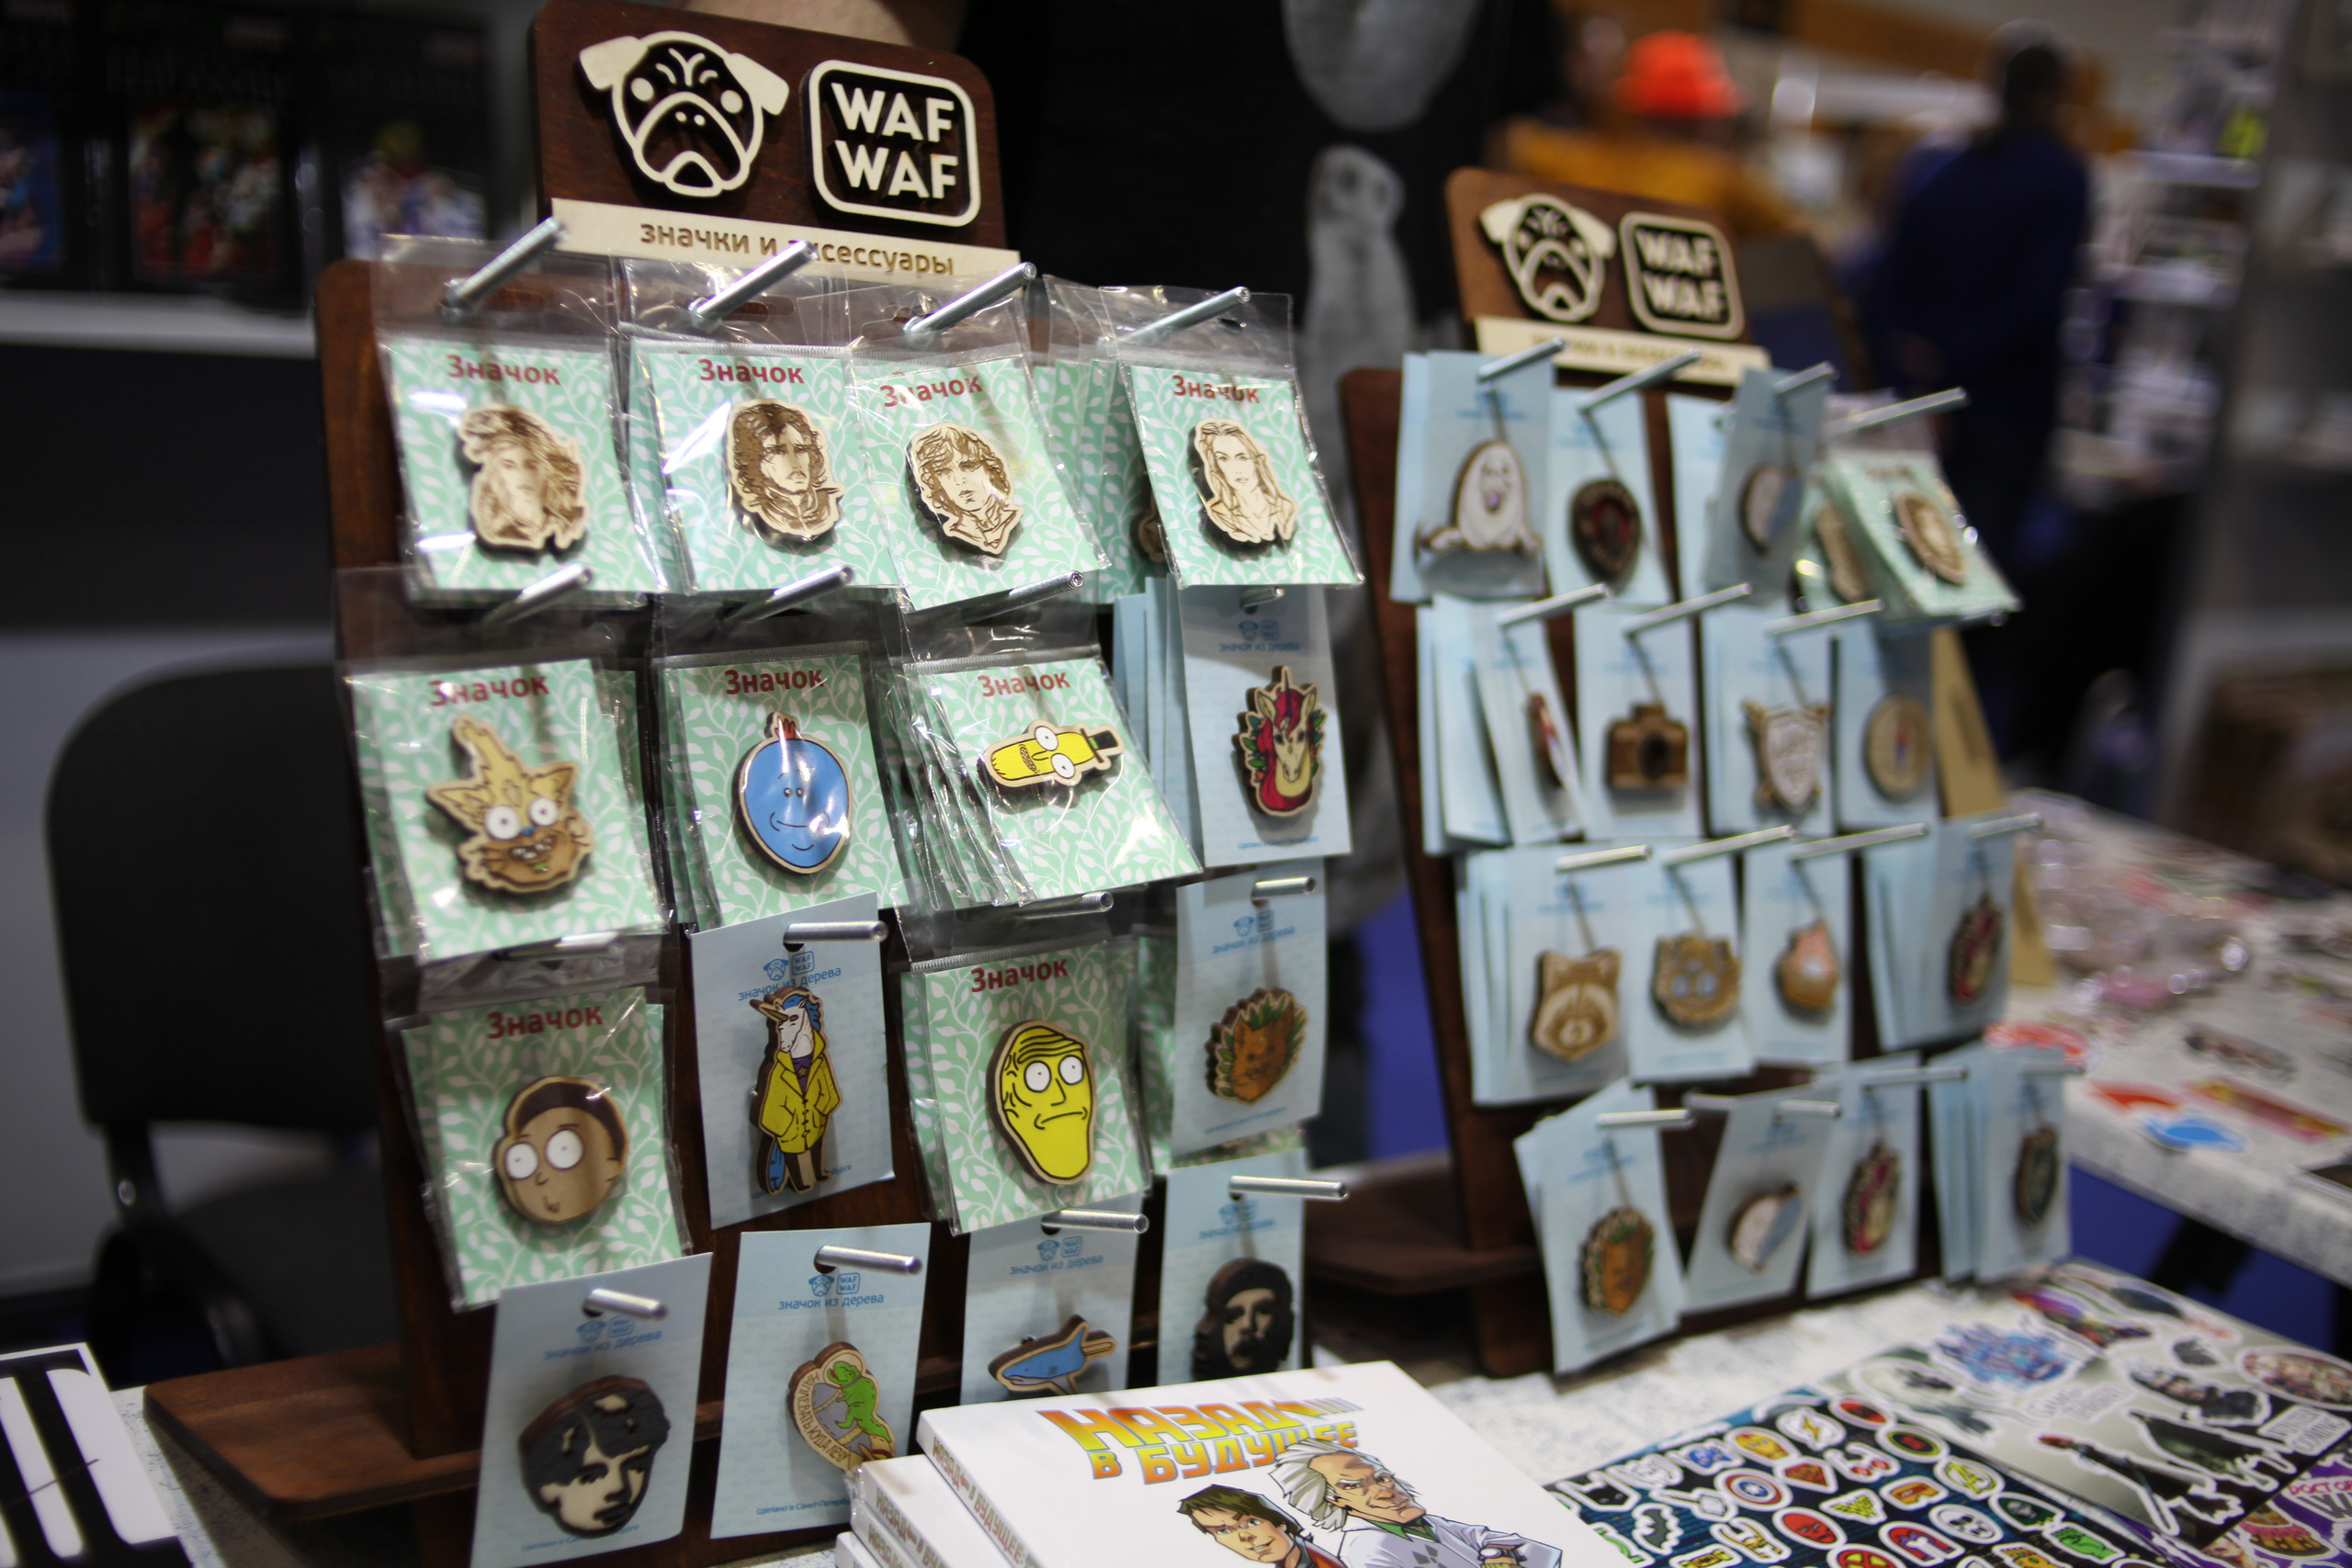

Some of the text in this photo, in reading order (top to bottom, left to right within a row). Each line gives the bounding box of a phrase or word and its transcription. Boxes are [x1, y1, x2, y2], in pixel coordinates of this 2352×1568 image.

[831, 83, 955, 142] WAF
[834, 140, 959, 199] WAF
[639, 223, 955, 277] значки и сессуары
[1636, 228, 1718, 276] WAF
[1643, 270, 1726, 321] WAF
[447, 354, 562, 386] Значок
[697, 358, 805, 384] Значок
[1172, 375, 1261, 403] Значок
[724, 669, 825, 694] Значок
[977, 672, 1070, 697] Значок
[738, 983, 779, 1001] значок
[799, 966, 842, 987] дерева
[970, 959, 1069, 993] Значок
[487, 1005, 604, 1039] Значок
[777, 1293, 884, 1311] значок из дерева
[1035, 1400, 1307, 1451] НАЗАД
